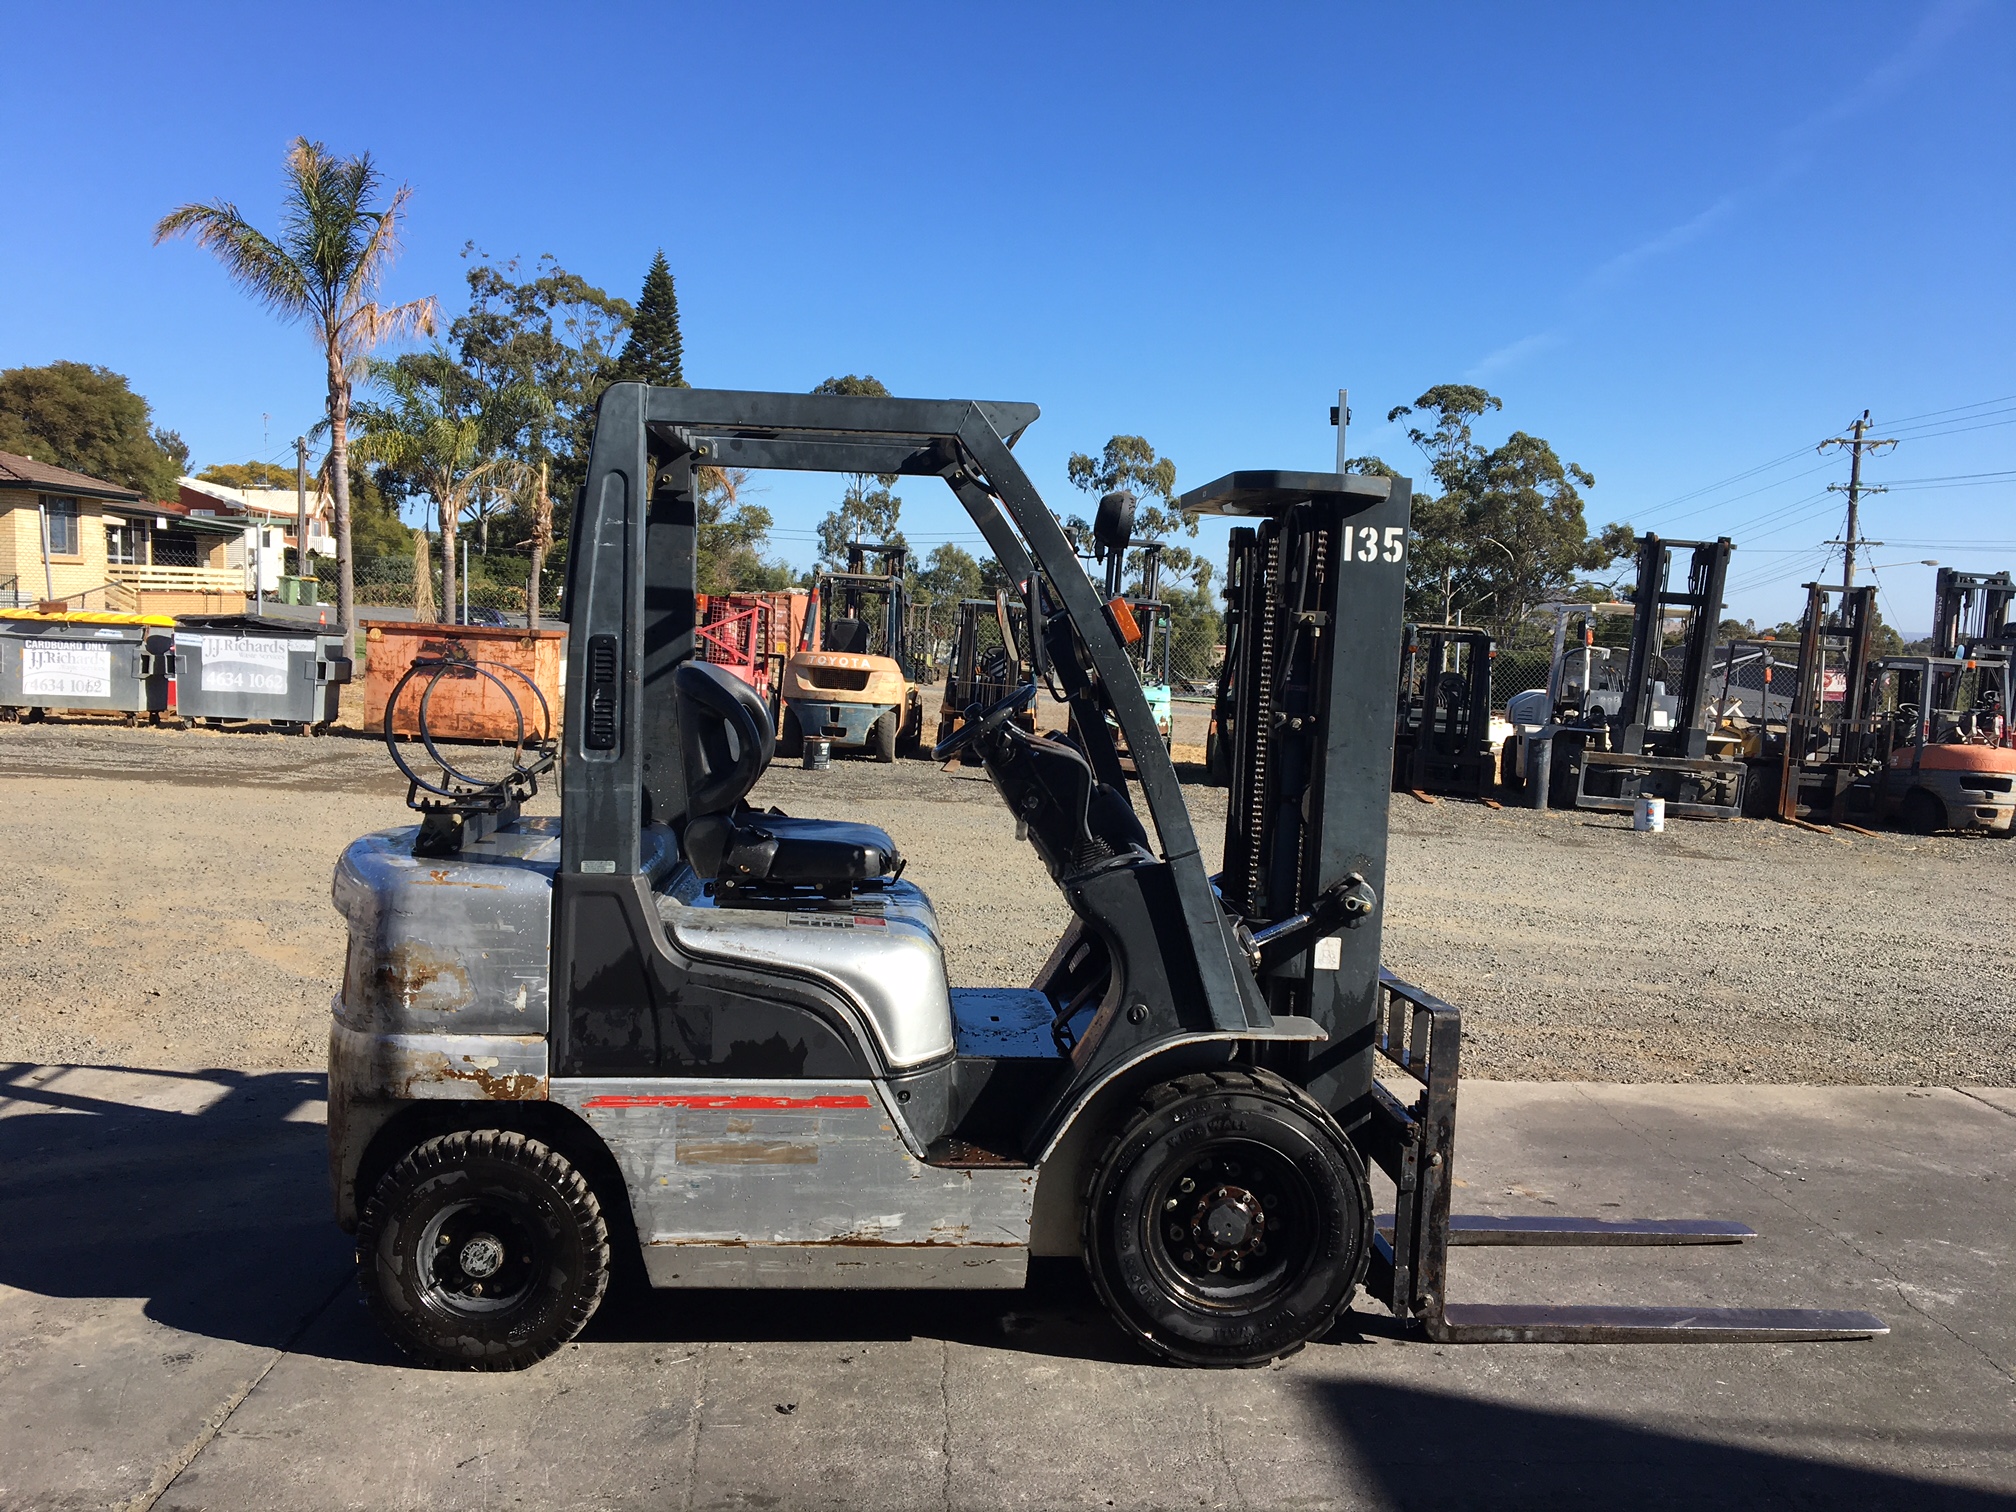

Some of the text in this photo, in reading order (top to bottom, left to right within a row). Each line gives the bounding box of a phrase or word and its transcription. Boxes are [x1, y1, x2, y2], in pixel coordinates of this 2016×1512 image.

[1343, 526, 1404, 562] 135
[25, 640, 108, 651] CARDBOARD ONLY
[808, 655, 871, 668] TOYOTA
[30, 678, 103, 693] 4634 1062
[206, 671, 284, 688] 4634 1062
